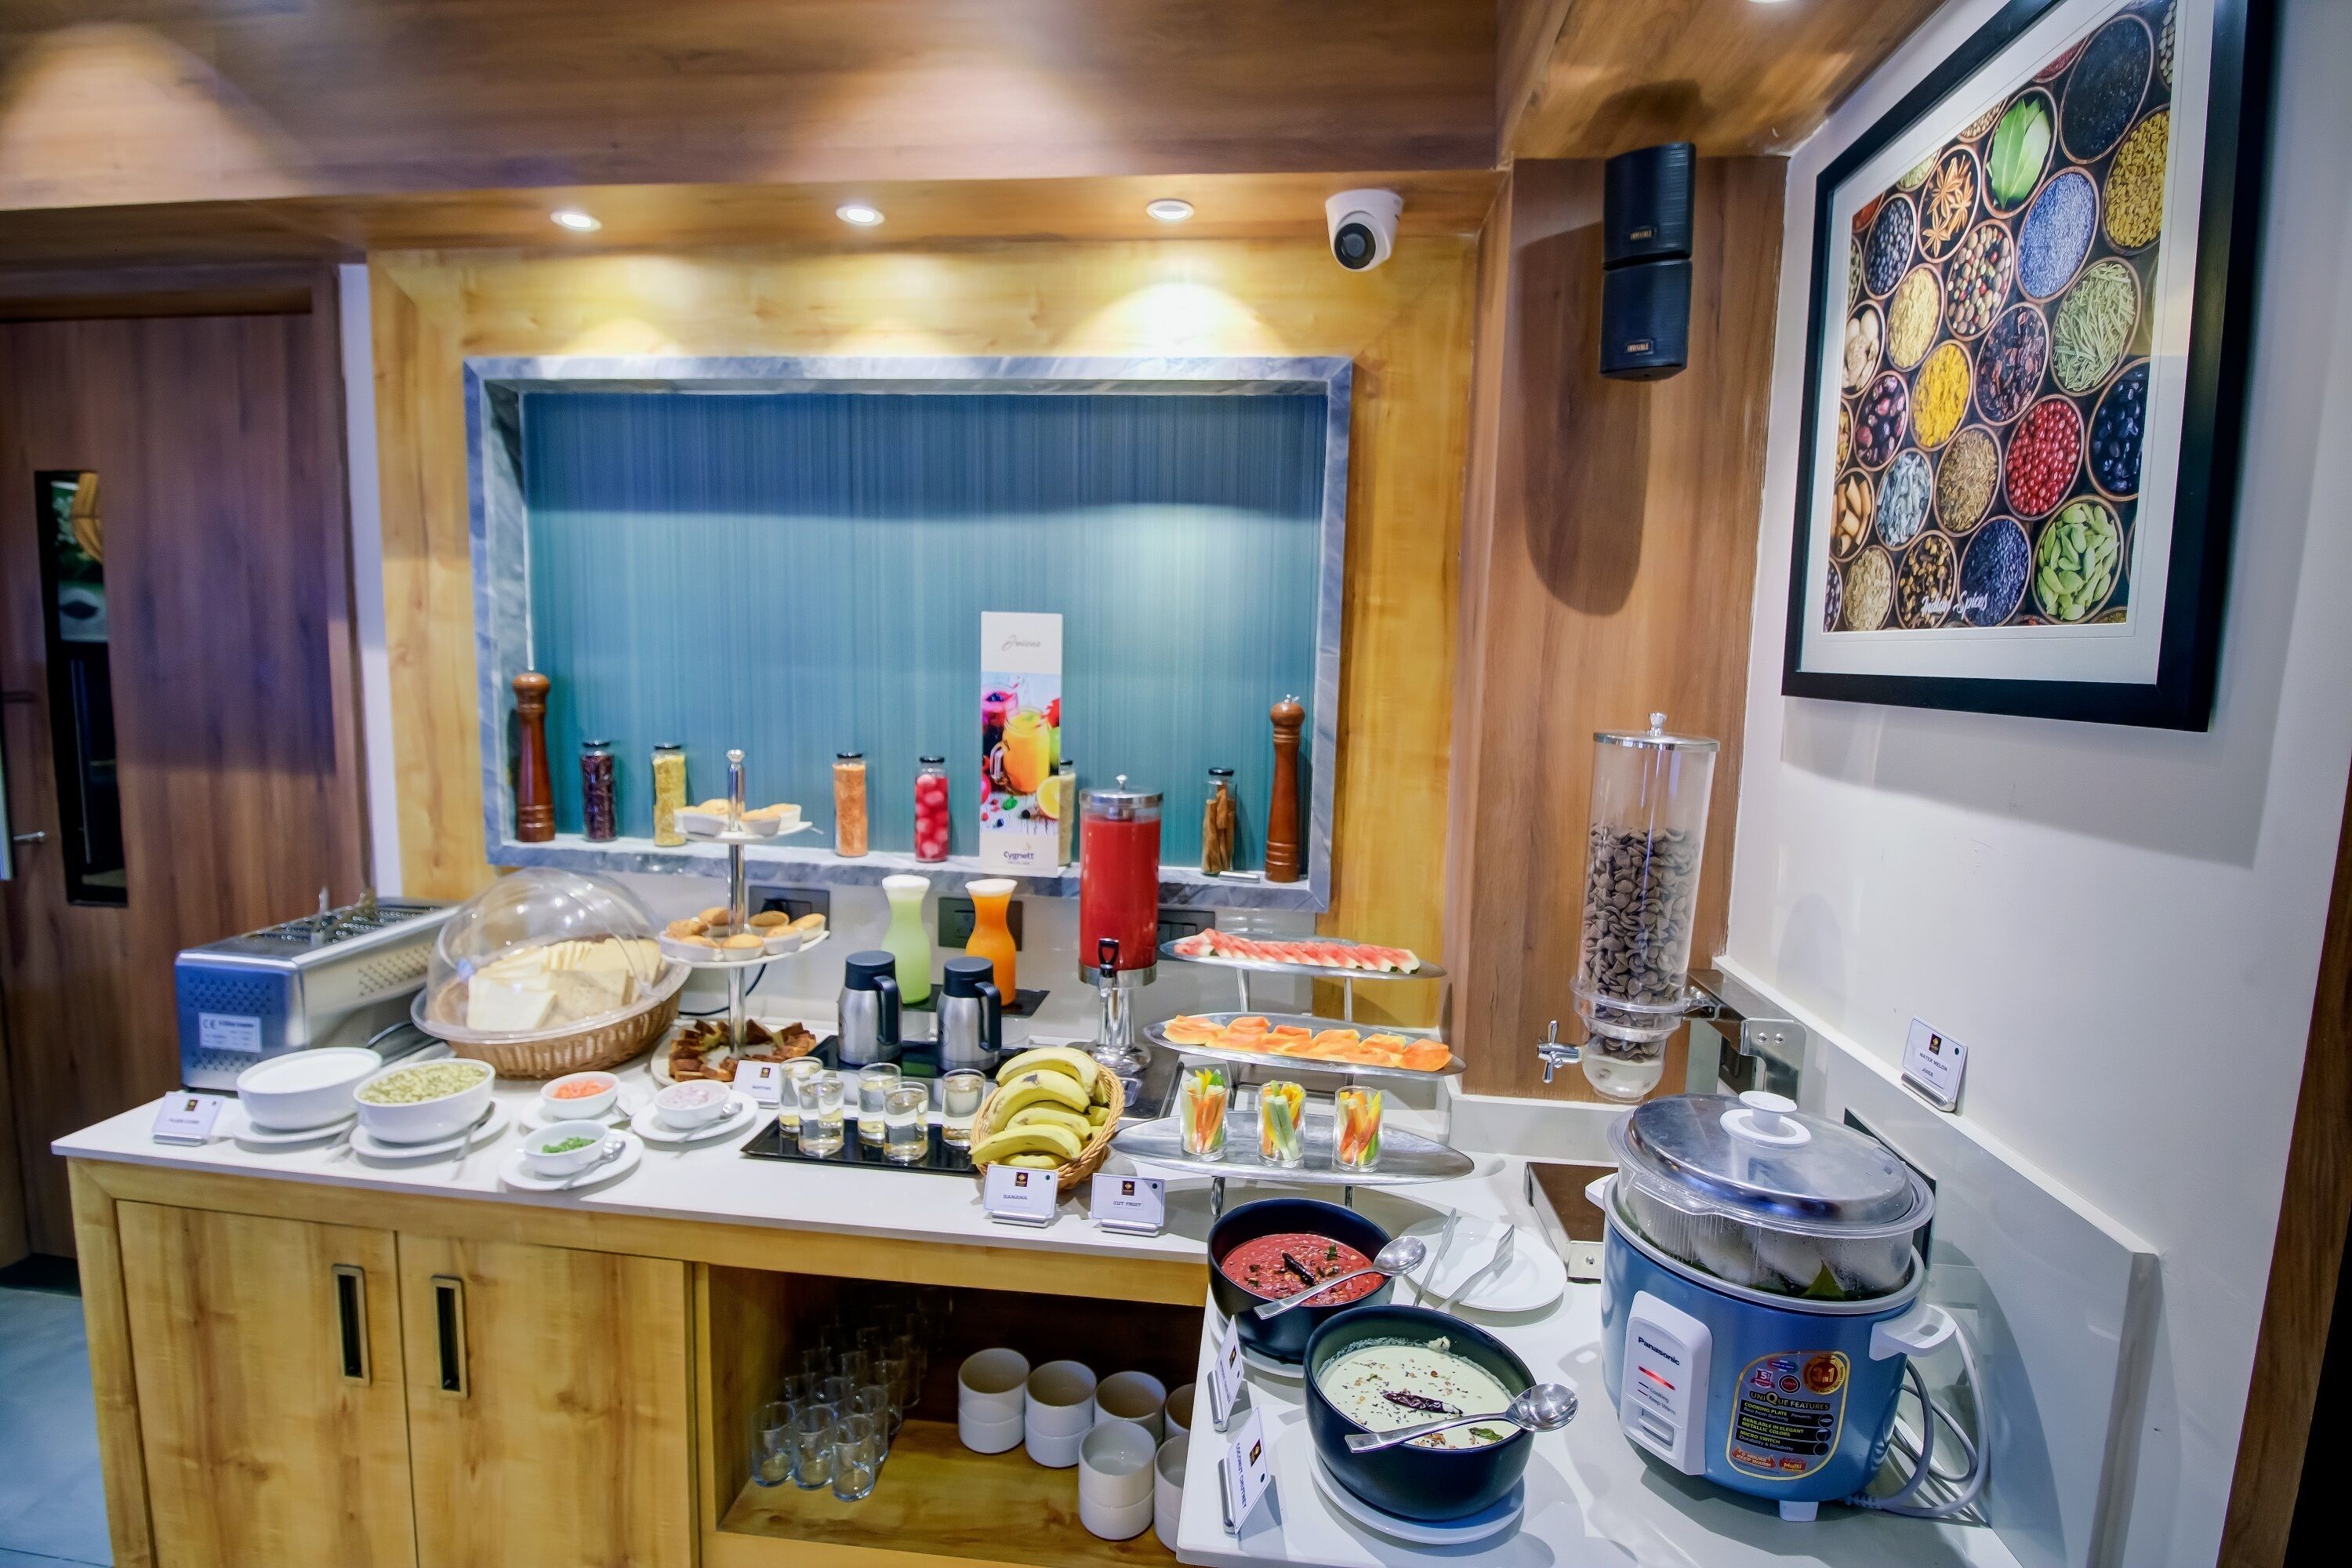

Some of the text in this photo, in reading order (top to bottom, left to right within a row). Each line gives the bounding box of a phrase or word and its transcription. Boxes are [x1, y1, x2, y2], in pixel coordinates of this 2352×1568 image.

[1920, 590, 1990, 621] Indian Spices
[1004, 851, 1035, 861] Cygnett
[1919, 1052, 1947, 1072] WATER MELON
[1638, 1336, 1680, 1367] Panasonic
[1761, 1370, 1768, 1380] 5
[1812, 1367, 1823, 1382] 3
[1828, 1367, 1835, 1383] 1
[1650, 1387, 1669, 1403] Cooking
[1751, 1392, 1829, 1410] UNIQUE FEATURES
[1649, 1396, 1676, 1415] Keep Warm
[1744, 1402, 1770, 1413] COOKING
[1741, 1421, 1791, 1437] METALLIC COLORS
[1742, 1417, 1772, 1428] AVAILABLE
[1739, 1435, 1764, 1446] Durability
[1740, 1430, 1780, 1444] MICRO SWITCH
